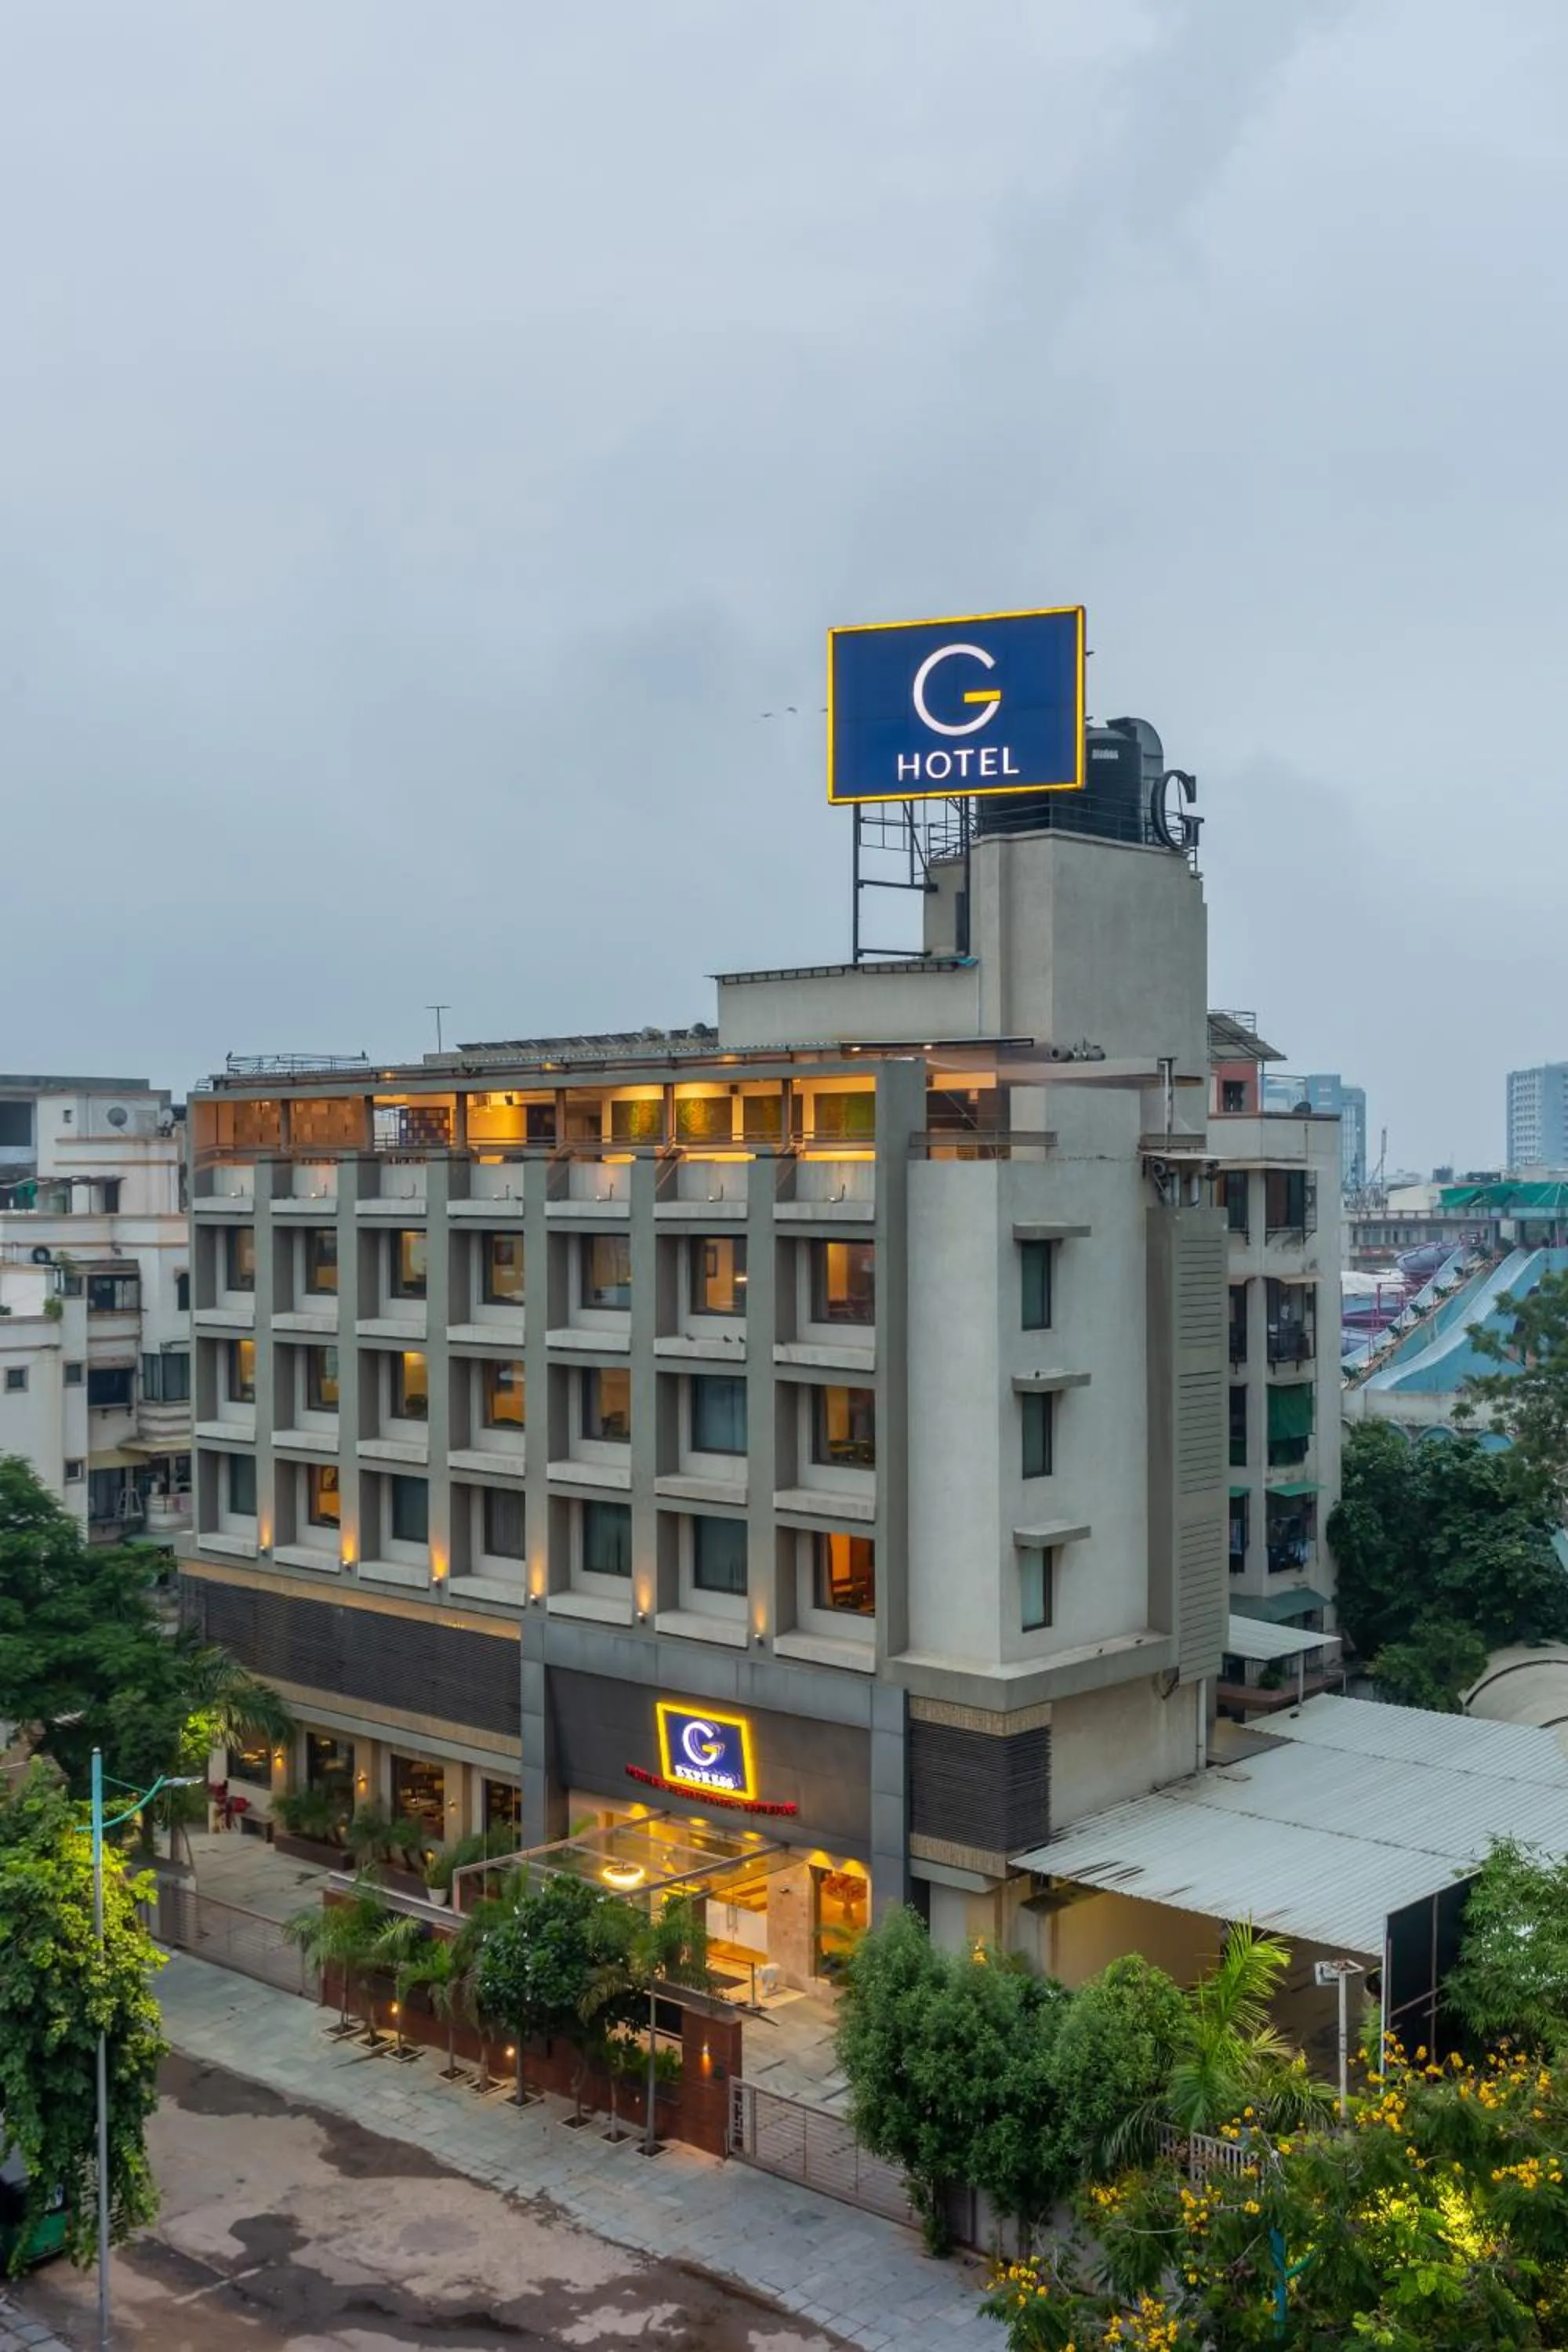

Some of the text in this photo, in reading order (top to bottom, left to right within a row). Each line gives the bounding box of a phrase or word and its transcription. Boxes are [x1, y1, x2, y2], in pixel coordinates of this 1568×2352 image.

[913, 644, 1001, 736] G
[898, 746, 1020, 781] HOTEL
[682, 1721, 718, 1766] G
